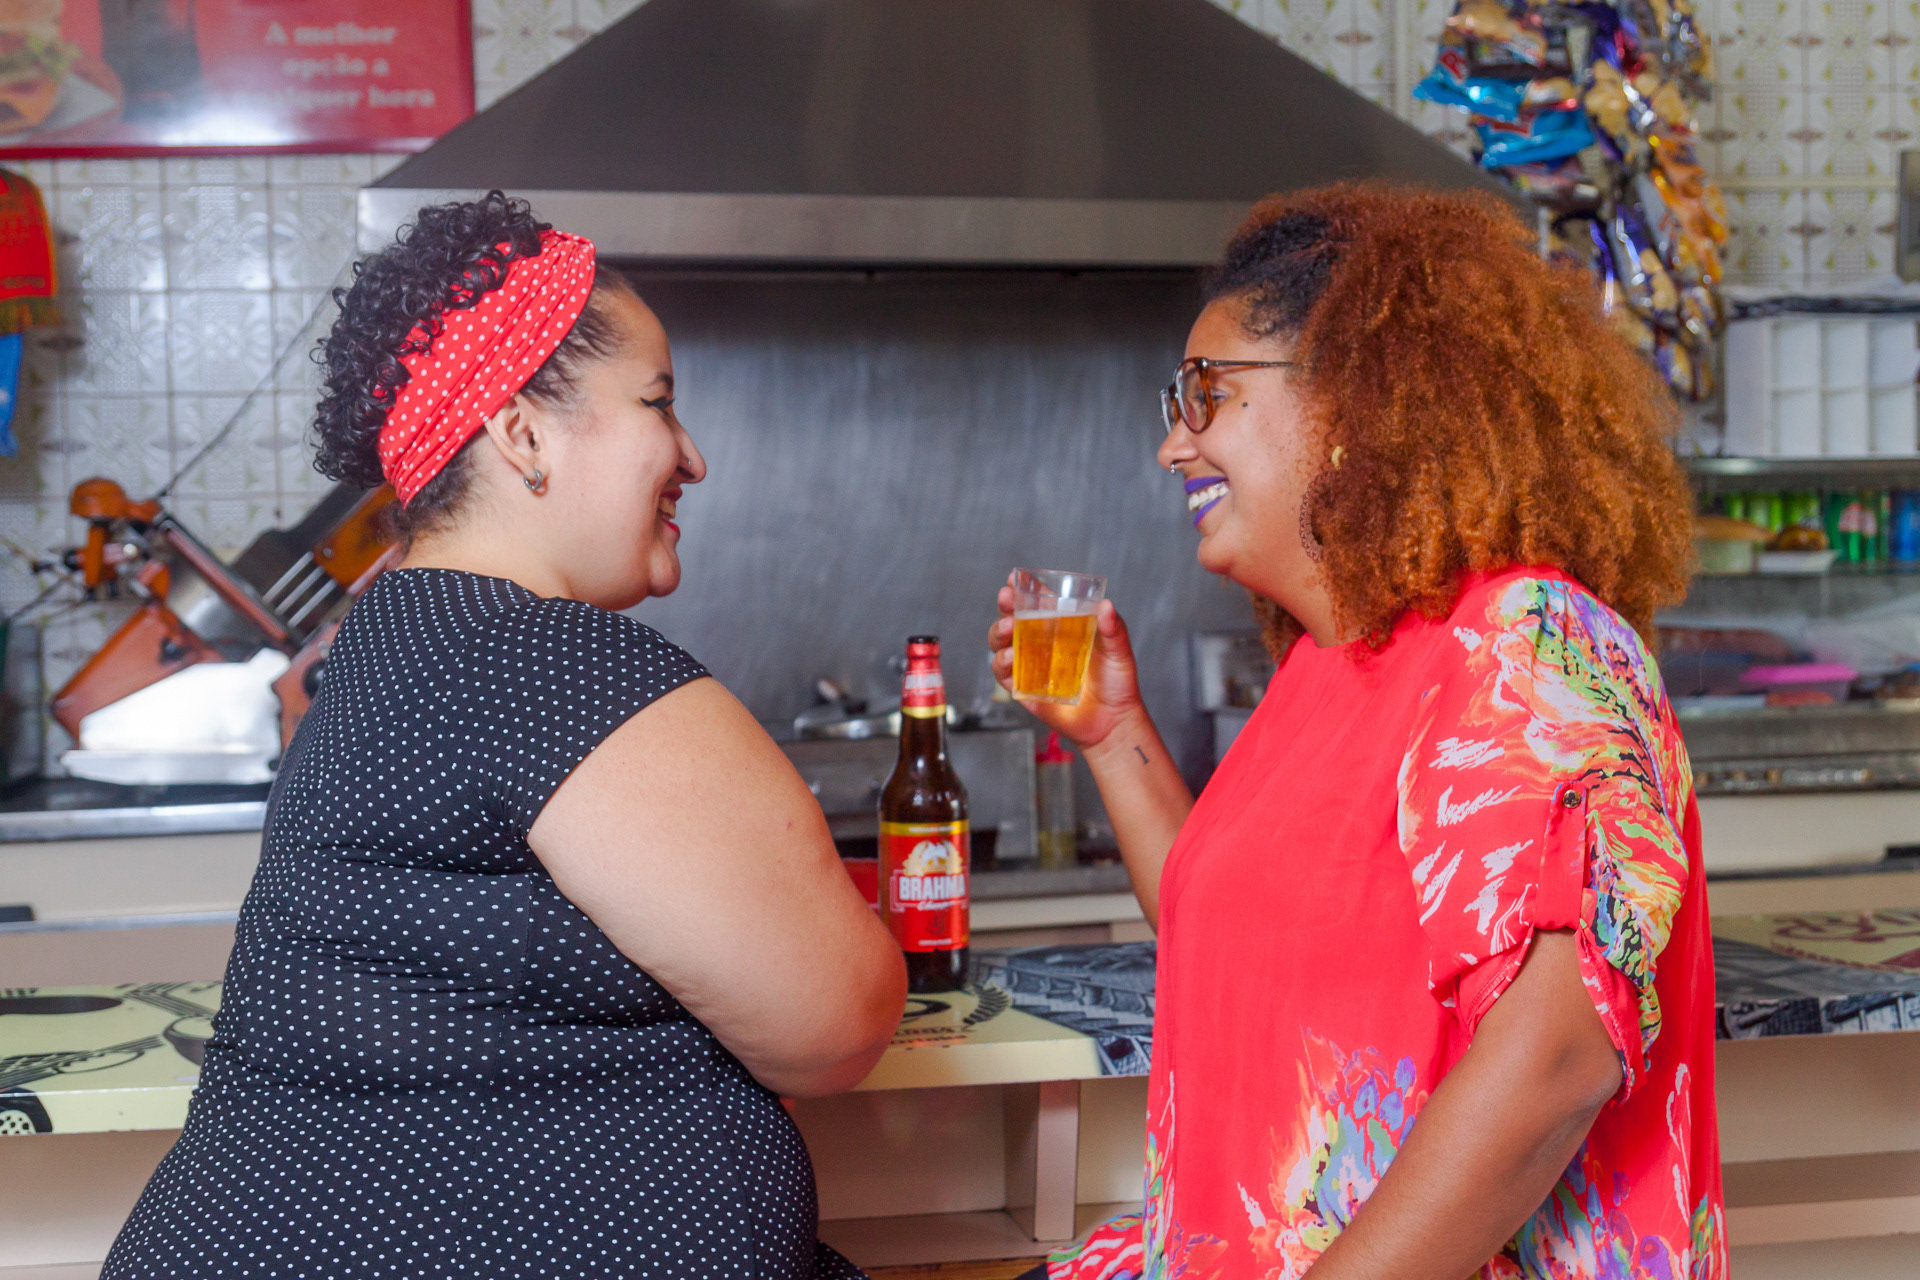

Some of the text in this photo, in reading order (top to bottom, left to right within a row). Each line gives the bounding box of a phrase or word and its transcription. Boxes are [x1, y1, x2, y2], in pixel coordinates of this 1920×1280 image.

[264, 21, 398, 45] A melhor
[372, 58, 390, 76] a
[232, 84, 436, 111] alquer hora
[899, 873, 966, 900] BRAHMA
